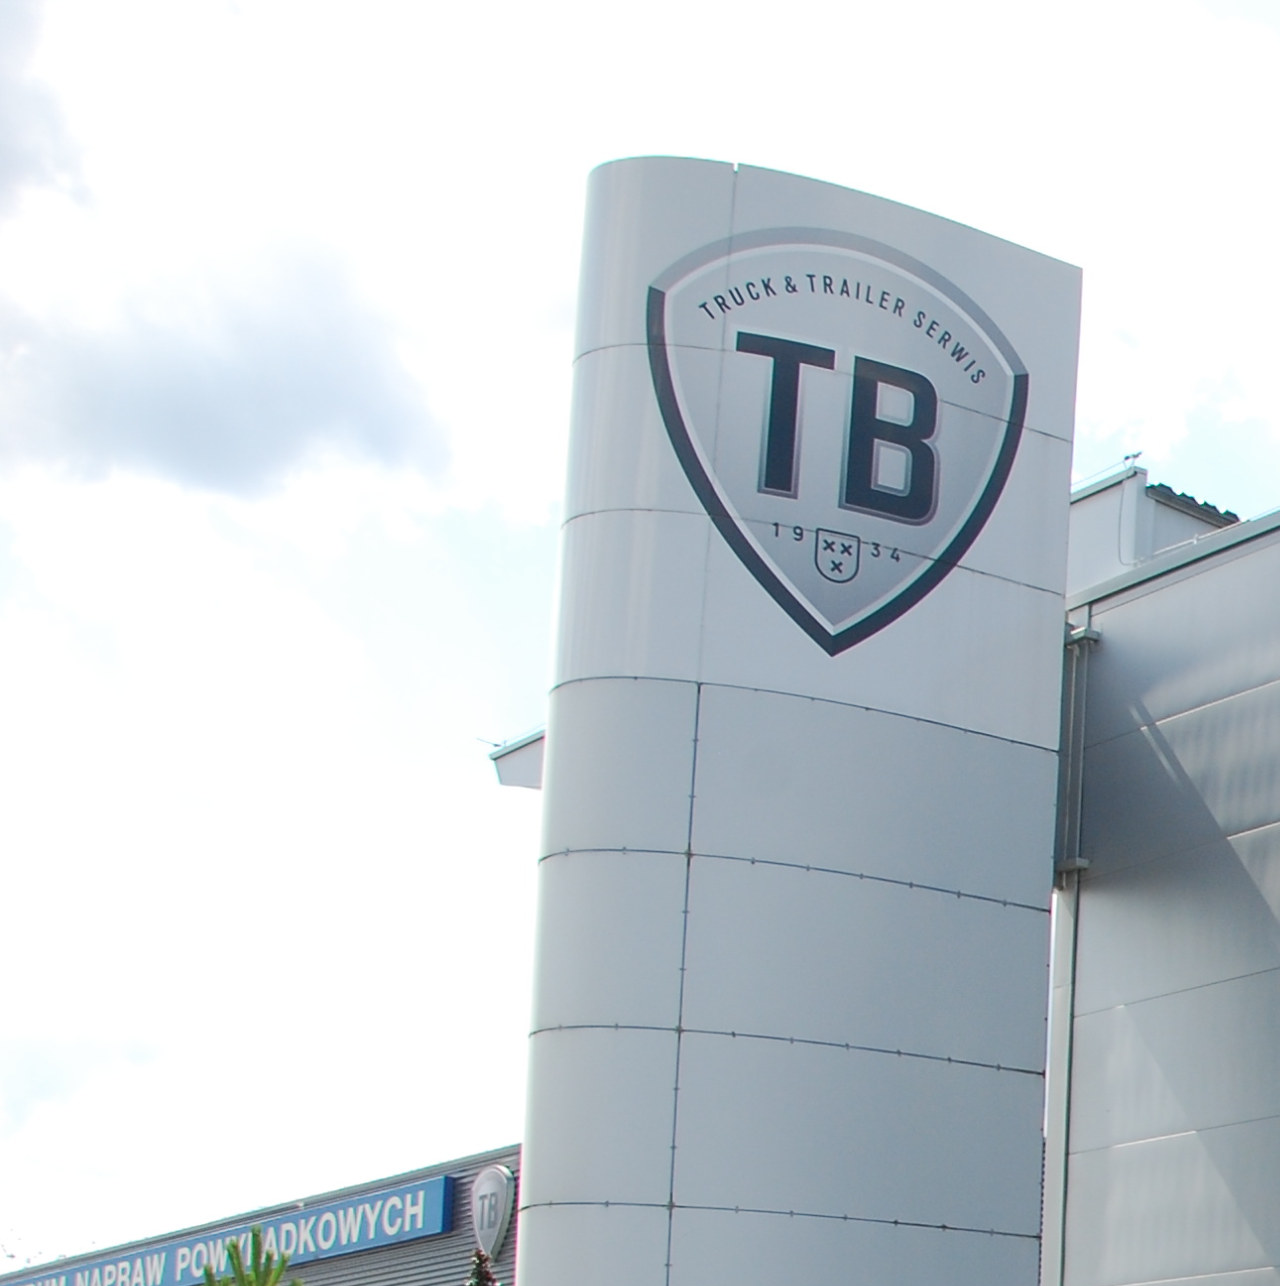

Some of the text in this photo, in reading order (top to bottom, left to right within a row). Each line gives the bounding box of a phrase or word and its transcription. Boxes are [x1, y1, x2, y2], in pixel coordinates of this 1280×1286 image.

[699, 274, 986, 384] TRUCK & TRAILER SERWIS
[735, 331, 939, 524] TB
[478, 1191, 498, 1231] TB
